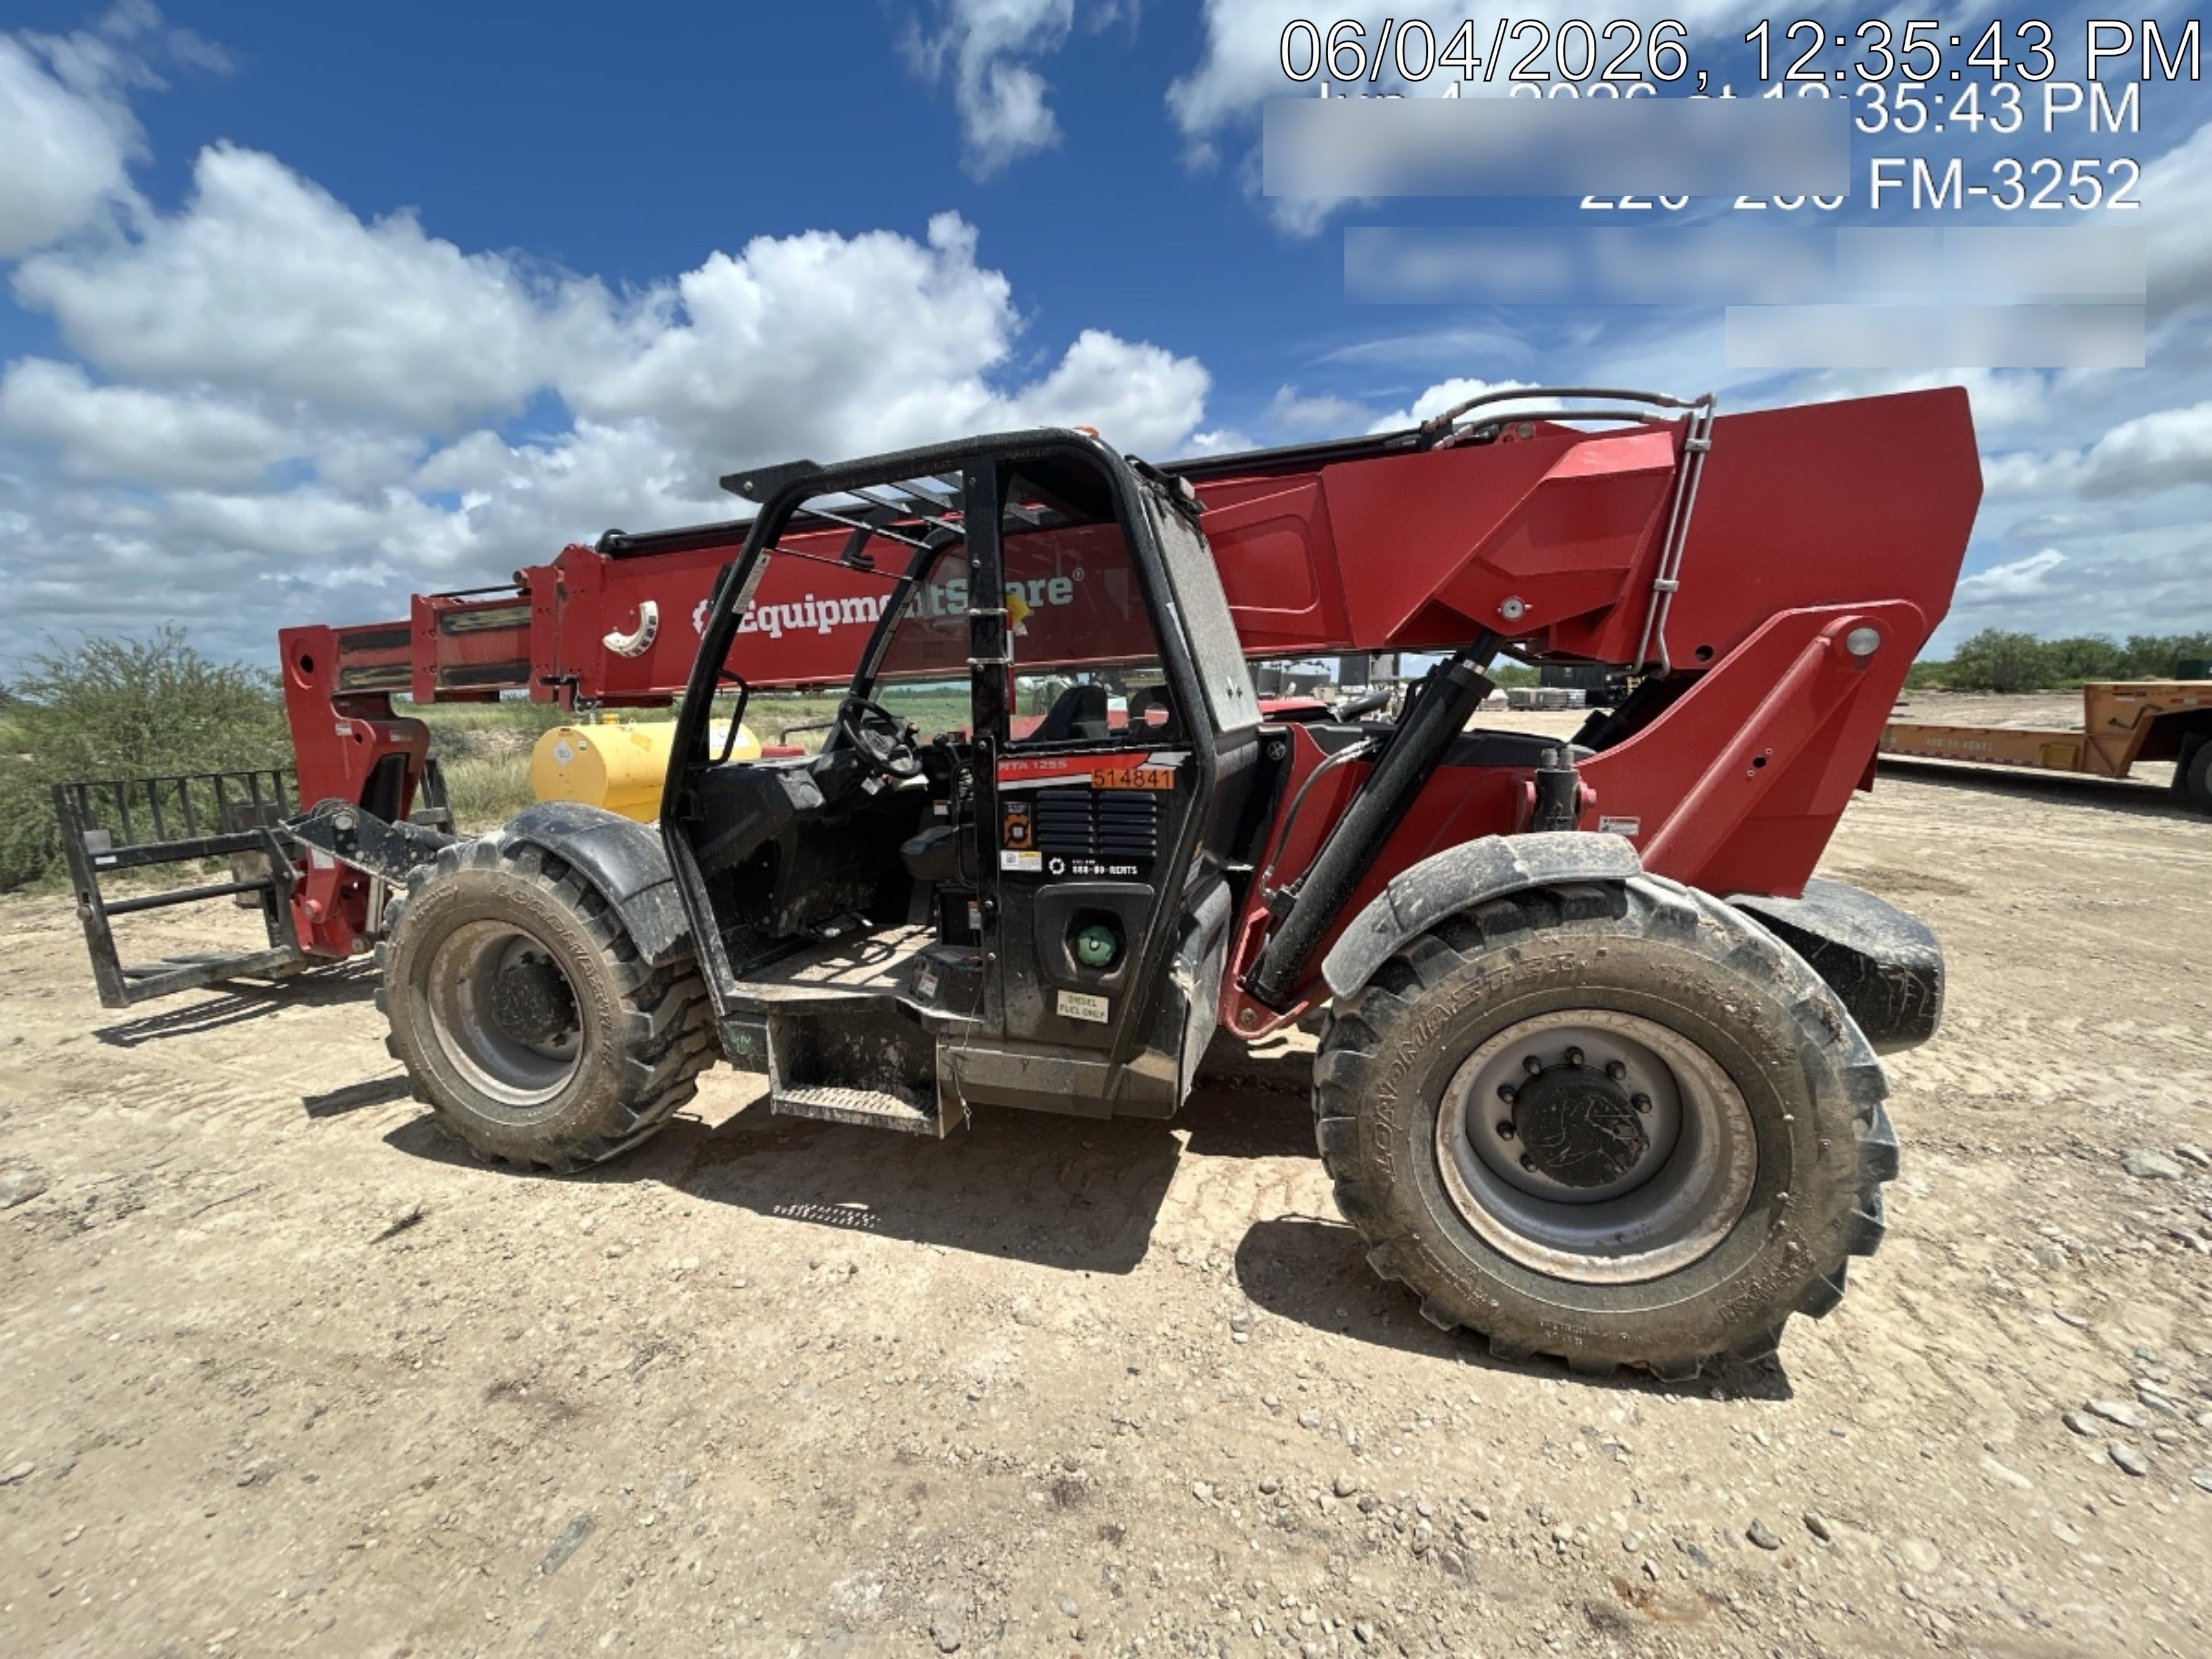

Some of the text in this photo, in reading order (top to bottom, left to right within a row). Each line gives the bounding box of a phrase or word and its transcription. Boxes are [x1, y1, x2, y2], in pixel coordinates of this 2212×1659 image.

[998, 761, 1029, 771] MTA
[1093, 769, 1171, 787] 514841
[1068, 995, 1097, 1006] DIESEL
[1060, 1004, 1105, 1019] FUEL ONLY
